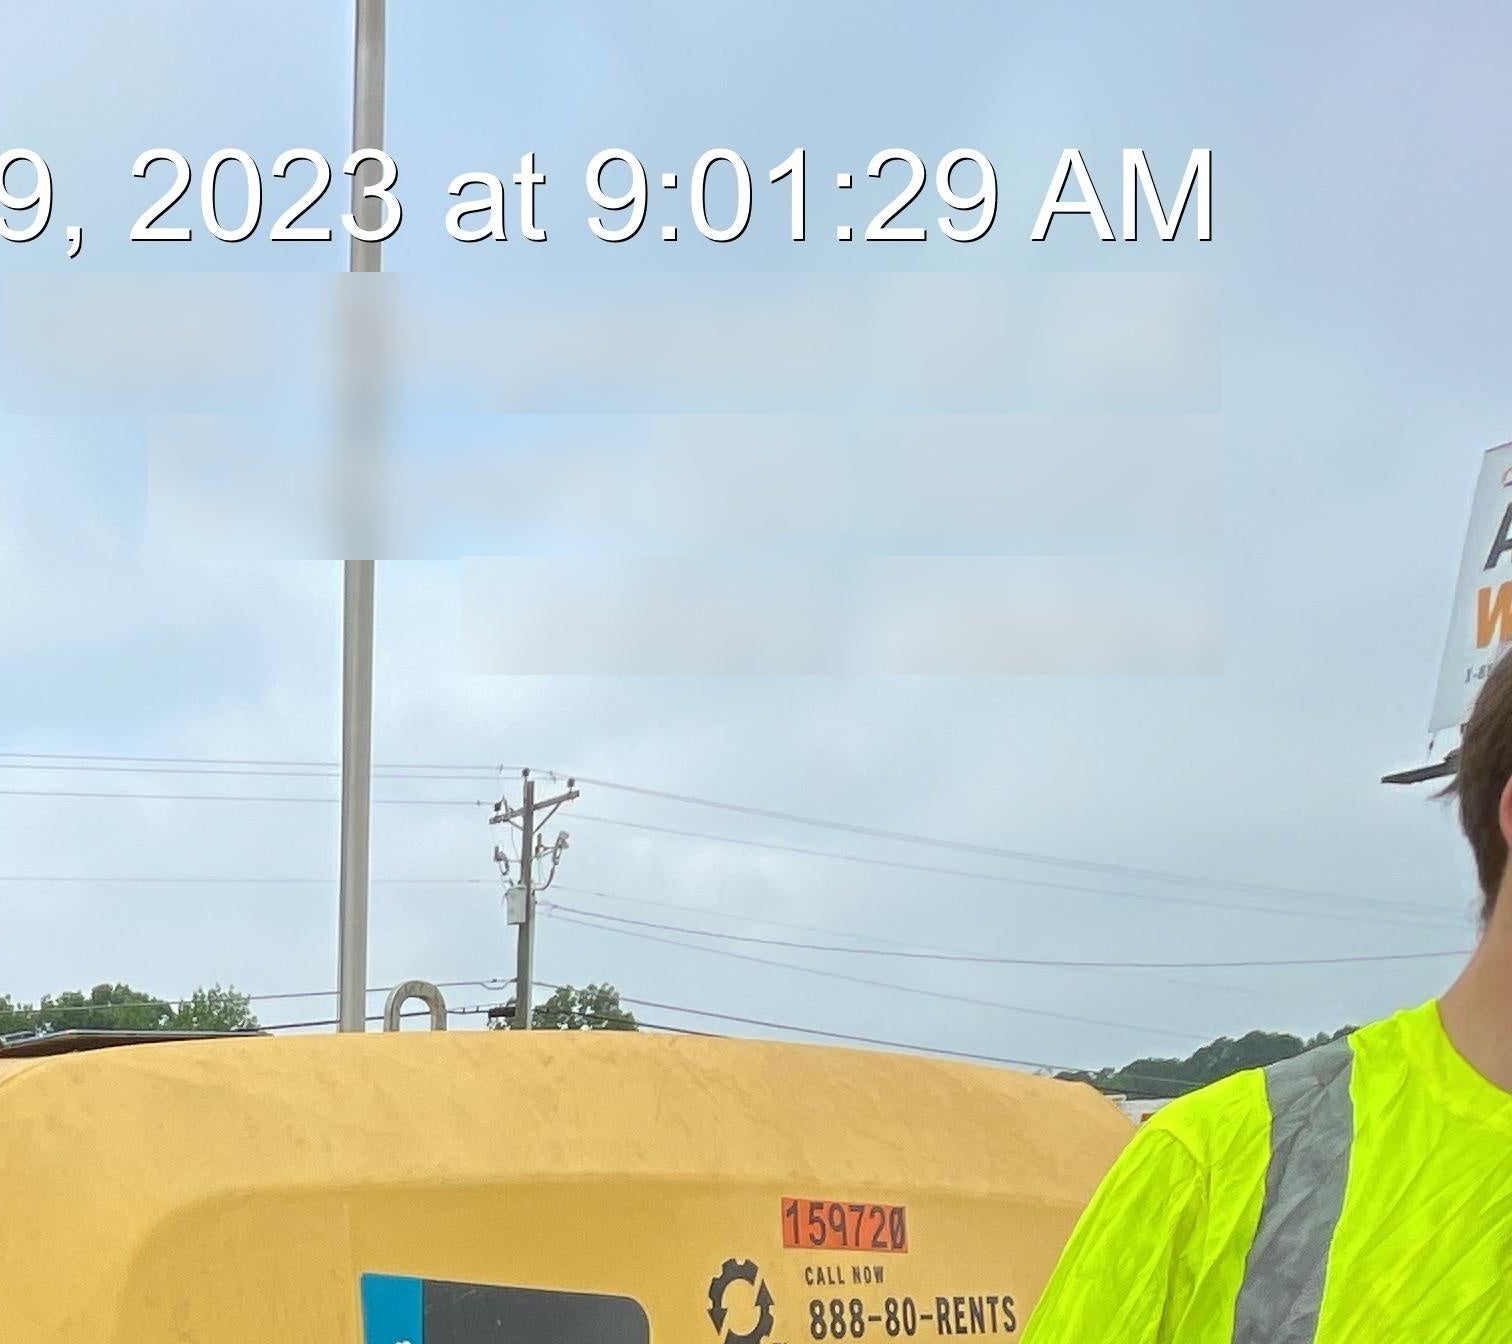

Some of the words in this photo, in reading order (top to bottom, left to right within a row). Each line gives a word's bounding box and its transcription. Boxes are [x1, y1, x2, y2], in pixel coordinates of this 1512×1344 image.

[785, 1200, 907, 1249] 159720
[804, 1265, 846, 1286] CALL
[851, 1265, 884, 1285] NOW
[809, 1295, 1018, 1340] 888-80-RENTS
